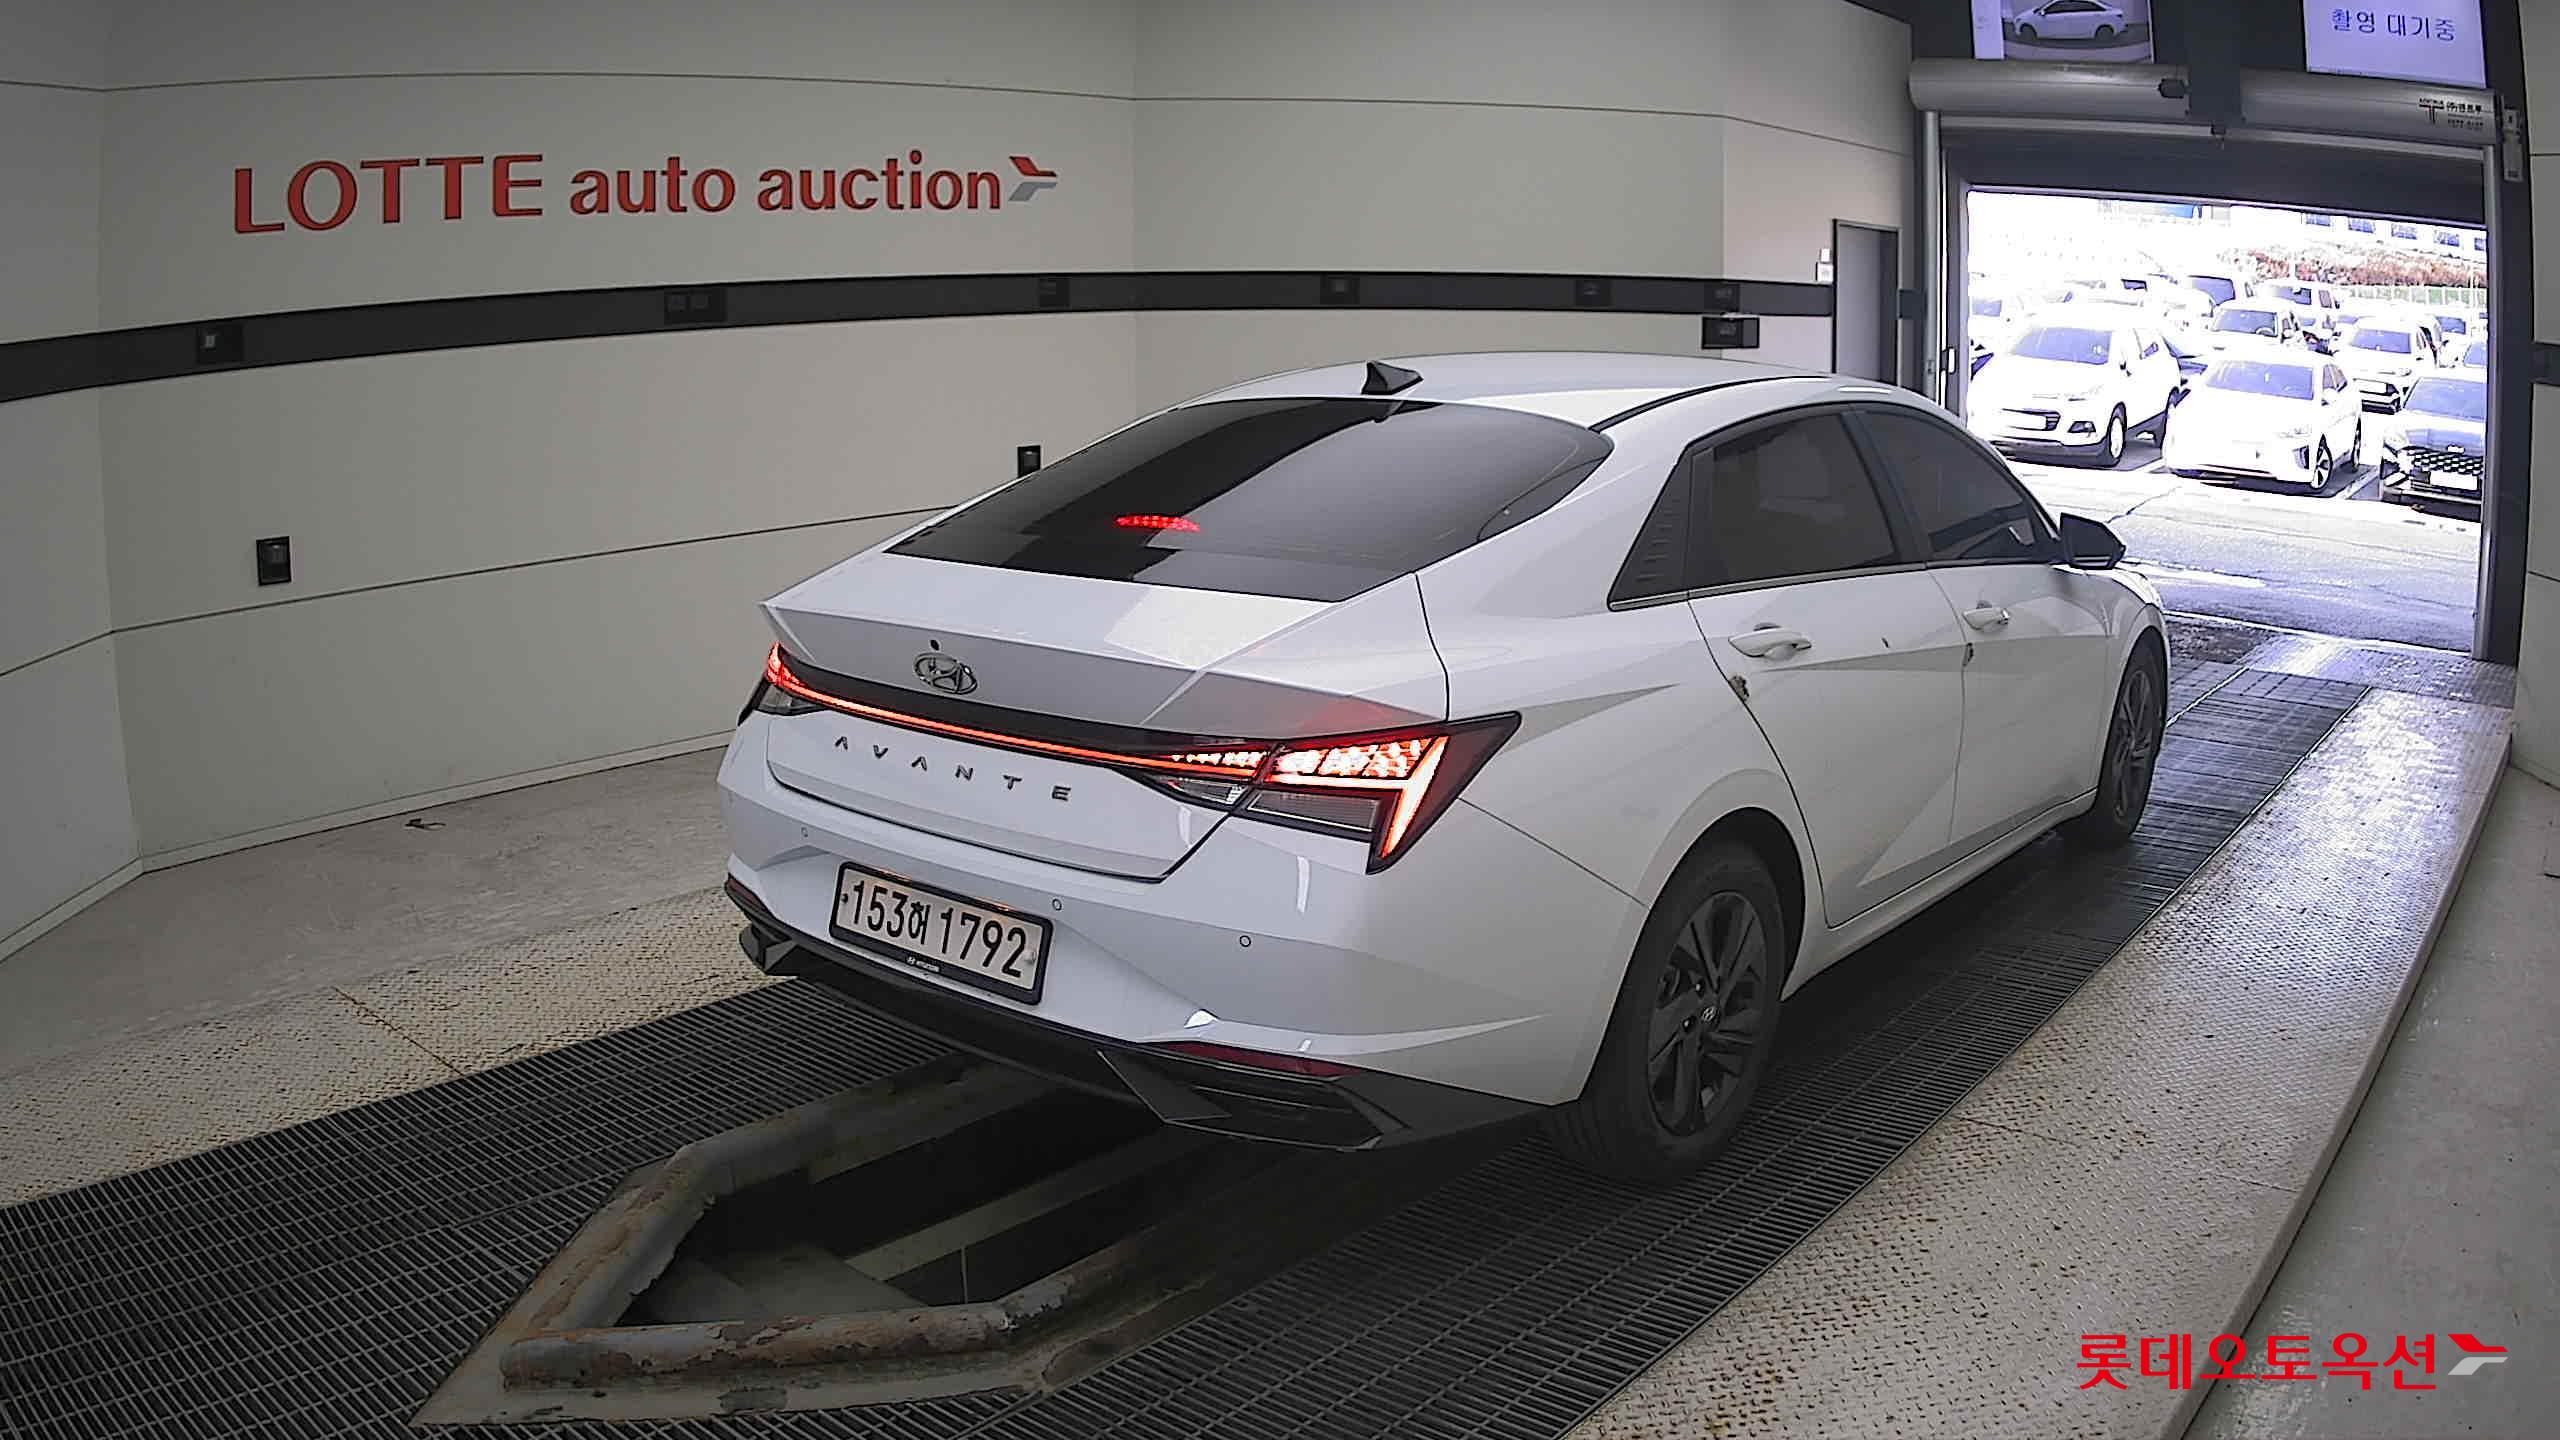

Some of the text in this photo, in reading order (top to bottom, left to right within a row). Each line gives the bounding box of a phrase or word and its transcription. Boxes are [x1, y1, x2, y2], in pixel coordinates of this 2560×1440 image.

[2331, 8, 2376, 34] 촬영
[234, 149, 1002, 235] LOTTE auto auction
[834, 735, 1073, 803] AVANTE
[852, 879, 1027, 979] 153허 1792
